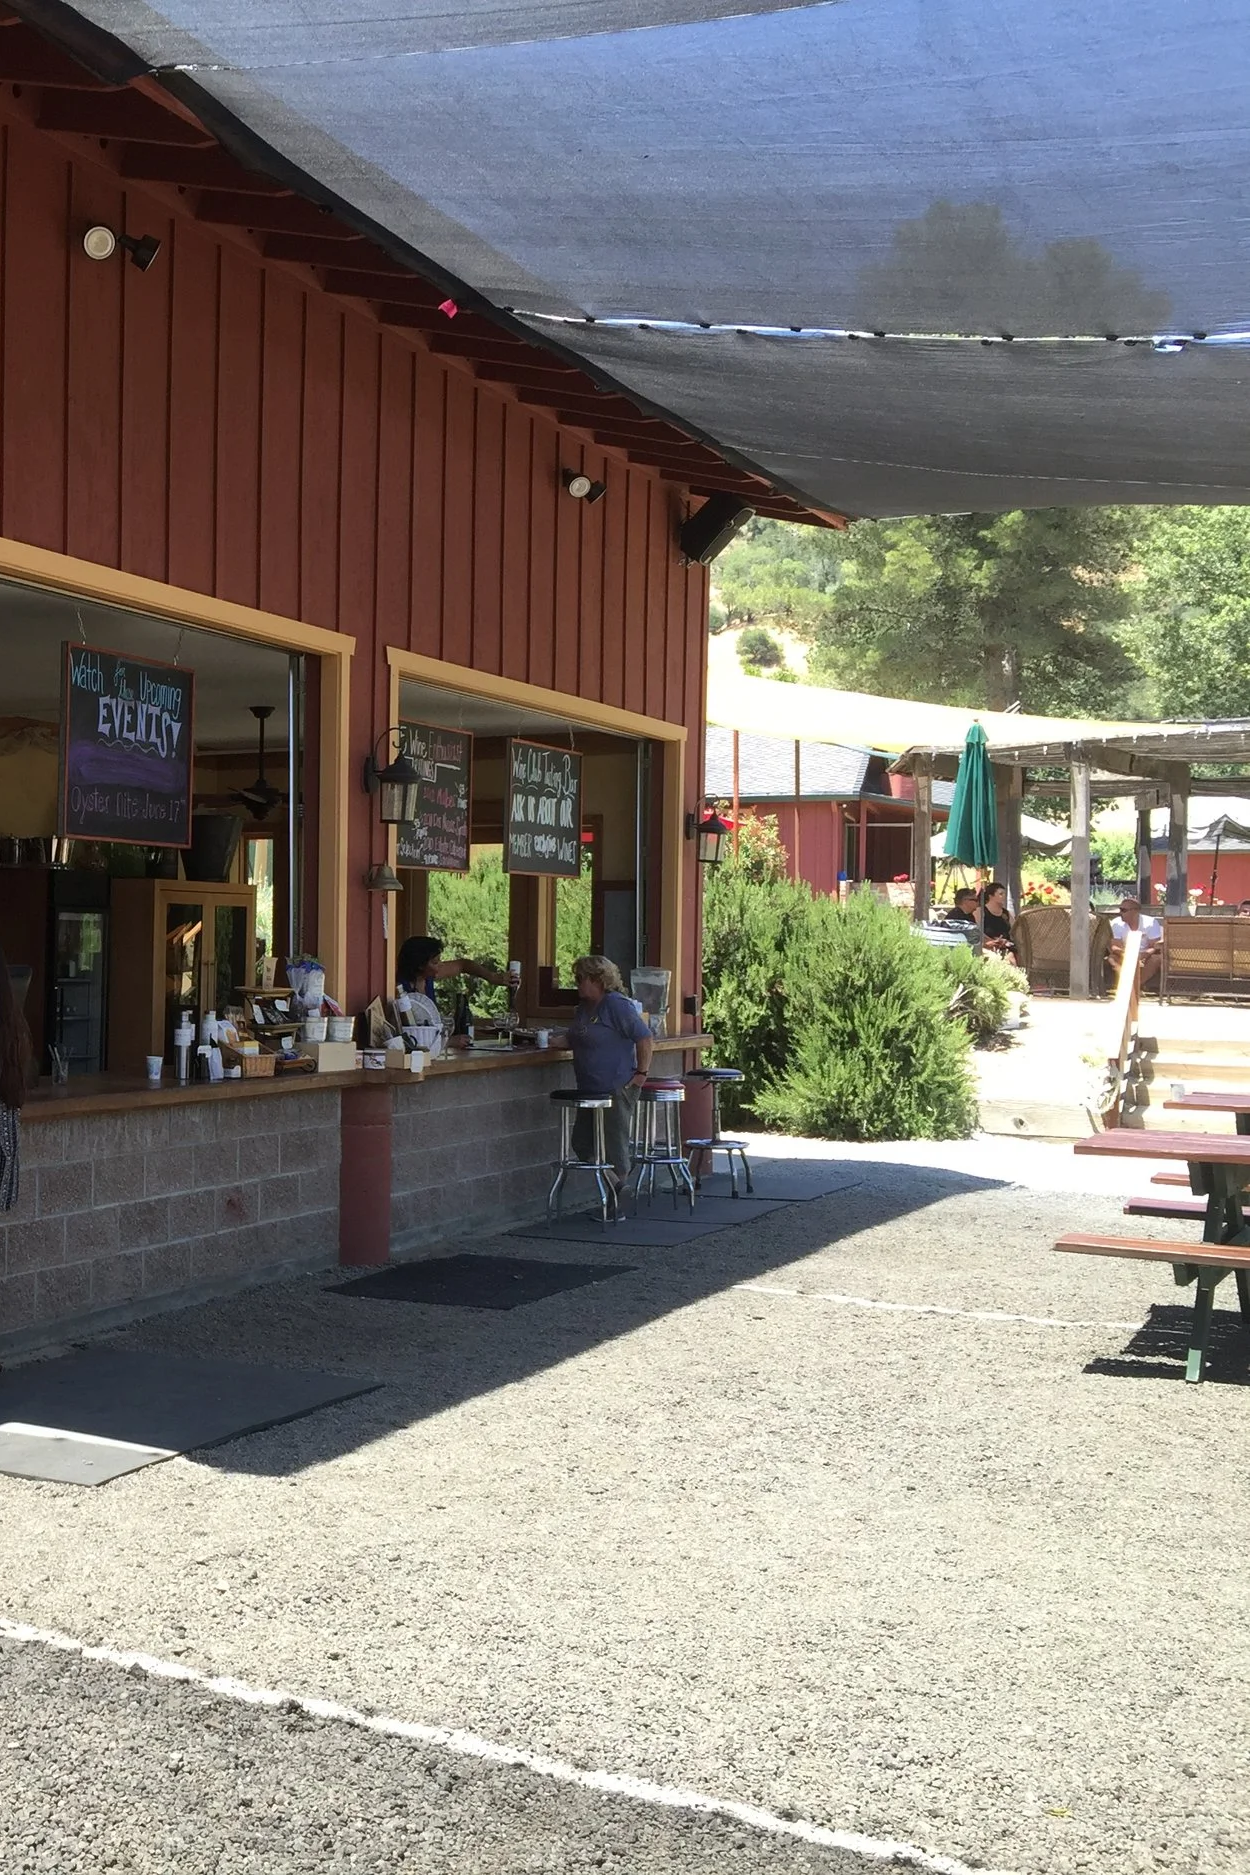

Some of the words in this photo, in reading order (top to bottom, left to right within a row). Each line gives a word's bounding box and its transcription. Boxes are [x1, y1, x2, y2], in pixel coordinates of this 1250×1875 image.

[70, 652, 104, 694] Watch
[140, 671, 182, 719] Upcoming
[98, 695, 183, 759] EVENTS!
[71, 786, 110, 824] Oyster
